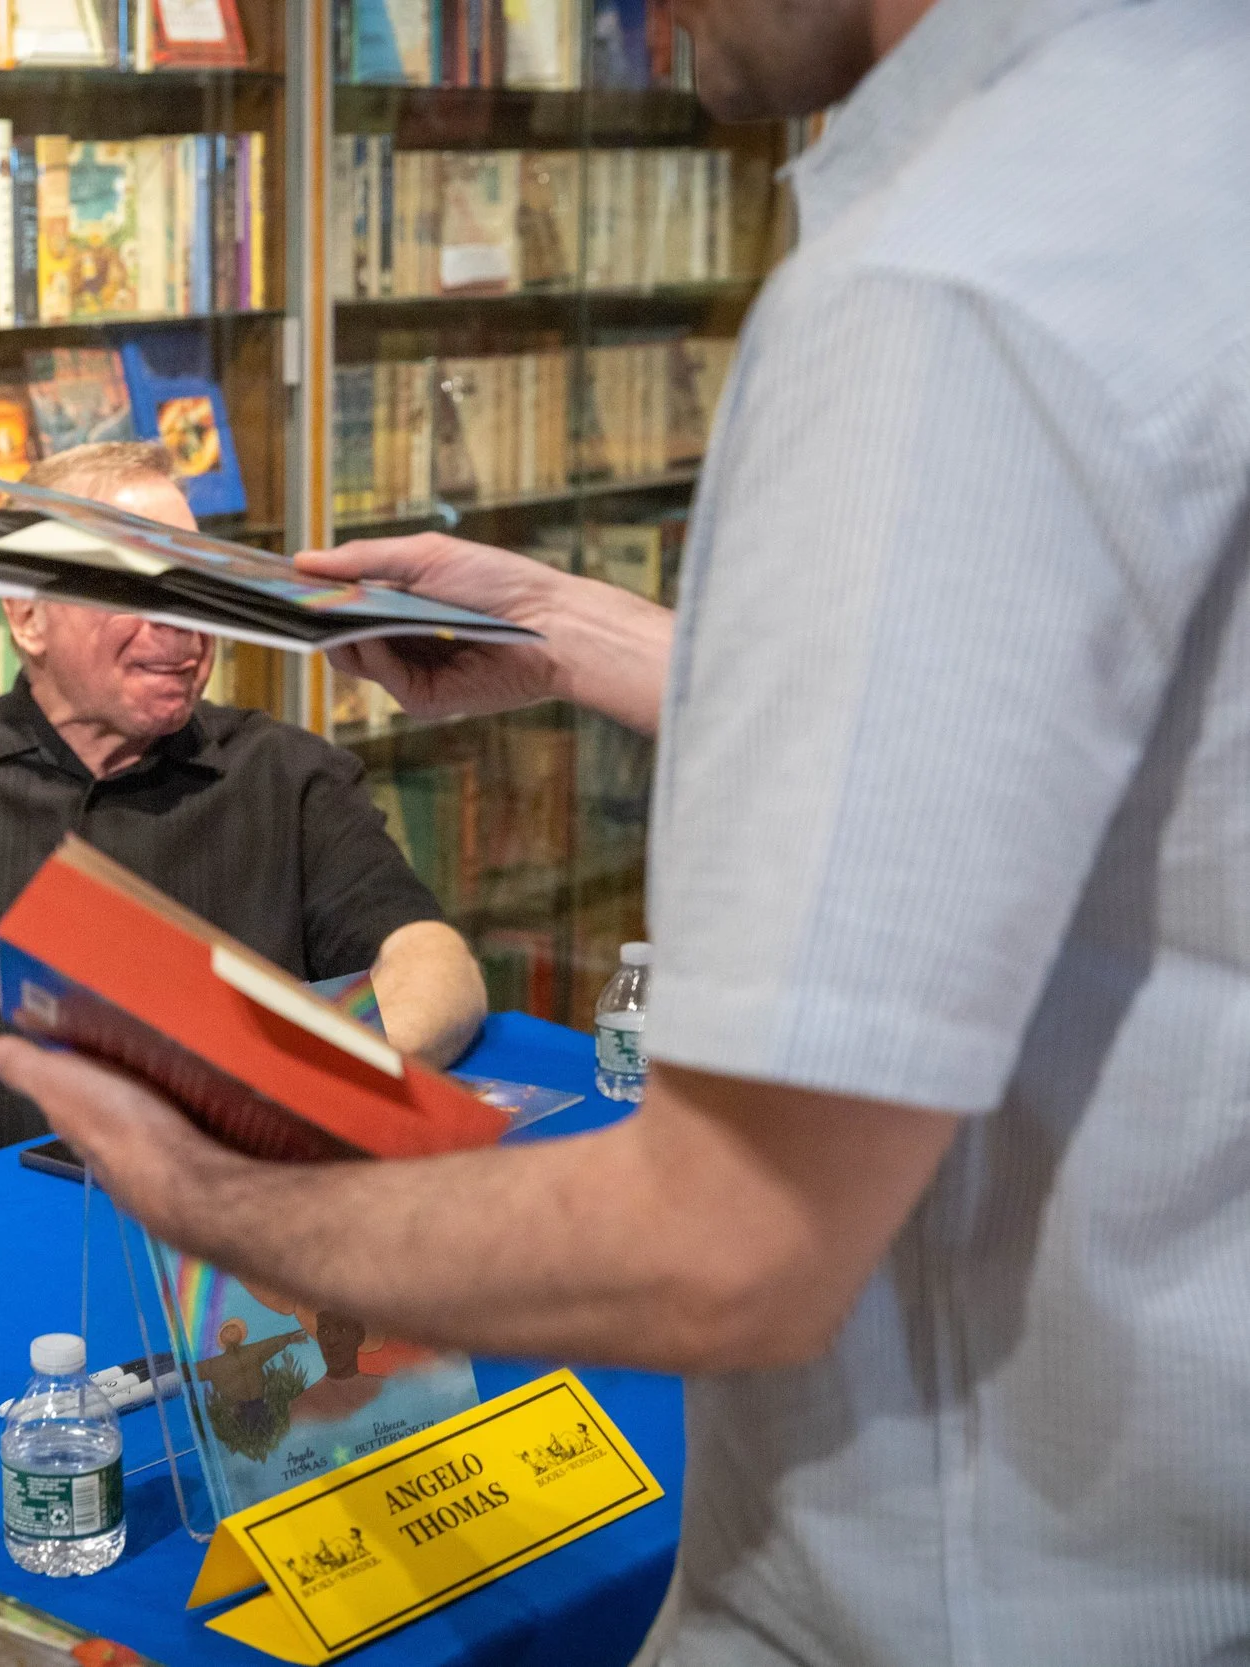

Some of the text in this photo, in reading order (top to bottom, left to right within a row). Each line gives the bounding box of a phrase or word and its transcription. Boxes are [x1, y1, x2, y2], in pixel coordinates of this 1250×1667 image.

[355, 1419, 435, 1455] BUTTERWORTH
[372, 1419, 407, 1437] Rebecca
[281, 1456, 328, 1481] THOMAS
[286, 1446, 316, 1467] Angelo
[384, 1452, 484, 1516] ANGELO
[535, 1467, 567, 1488] BOOKS
[398, 1481, 510, 1547] THOMAS
